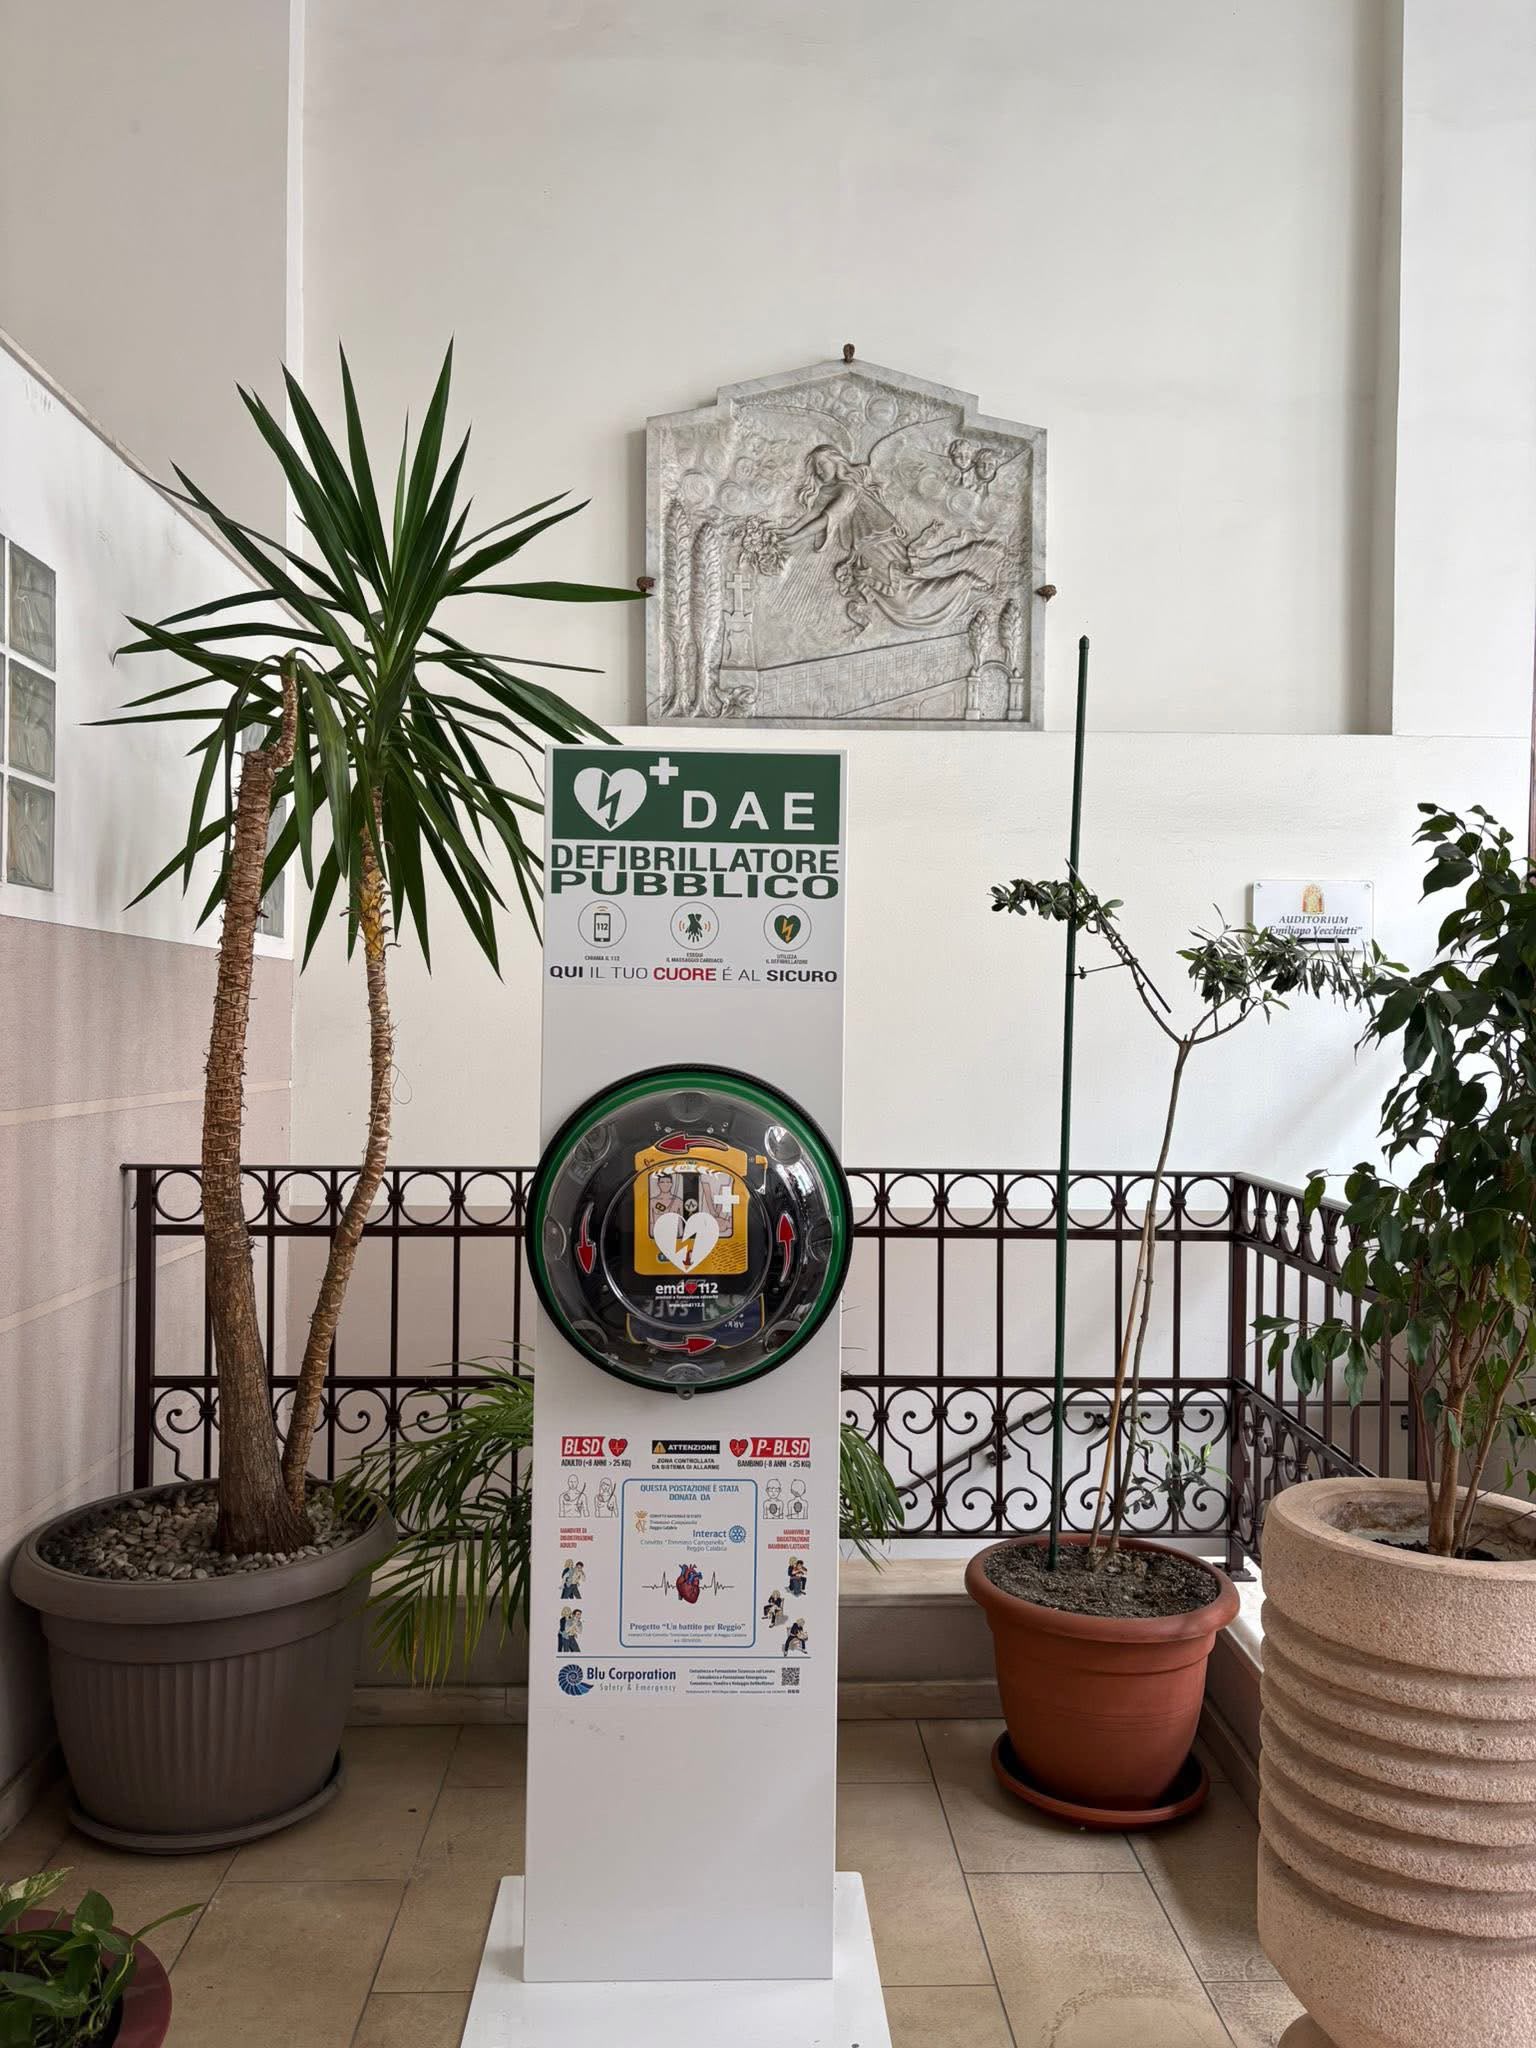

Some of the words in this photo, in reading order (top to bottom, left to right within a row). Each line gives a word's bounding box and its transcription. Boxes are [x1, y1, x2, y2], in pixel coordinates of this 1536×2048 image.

[683, 790, 815, 831] DAE
[551, 844, 840, 874] DEFIBRILLATORE
[551, 870, 839, 900] PUBBLICO
[1278, 915, 1349, 924] AUDITORIUM
[597, 923, 609, 931] 112
[550, 965, 583, 979] QUI
[590, 966, 606, 978] IL
[611, 966, 648, 979] TUO
[653, 967, 717, 981] CUORE
[738, 969, 760, 982] AL
[766, 969, 837, 983] SICURO
[563, 1438, 601, 1455] BLSD
[667, 1444, 718, 1452] ATTENZIONE
[561, 1459, 582, 1467] ADULTO
[593, 1459, 607, 1467] ANNI
[613, 1459, 620, 1467] 25
[621, 1459, 631, 1469] KG)
[737, 1460, 763, 1468] BAMBINO
[773, 1460, 786, 1468] ANNI
[793, 1460, 800, 1468] 25
[801, 1460, 811, 1469] KG)
[640, 1484, 667, 1493] QUESTA
[669, 1484, 711, 1493] POSTAZIONE
[719, 1485, 739, 1493] STATA
[669, 1493, 697, 1501] DONATA
[693, 1529, 727, 1538] Interact
[629, 1623, 660, 1631] Progetto
[587, 1666, 605, 1680] Blu
[609, 1667, 676, 1682] Corporation
[600, 1682, 623, 1692] Safety
[635, 1684, 676, 1692] Emergency
